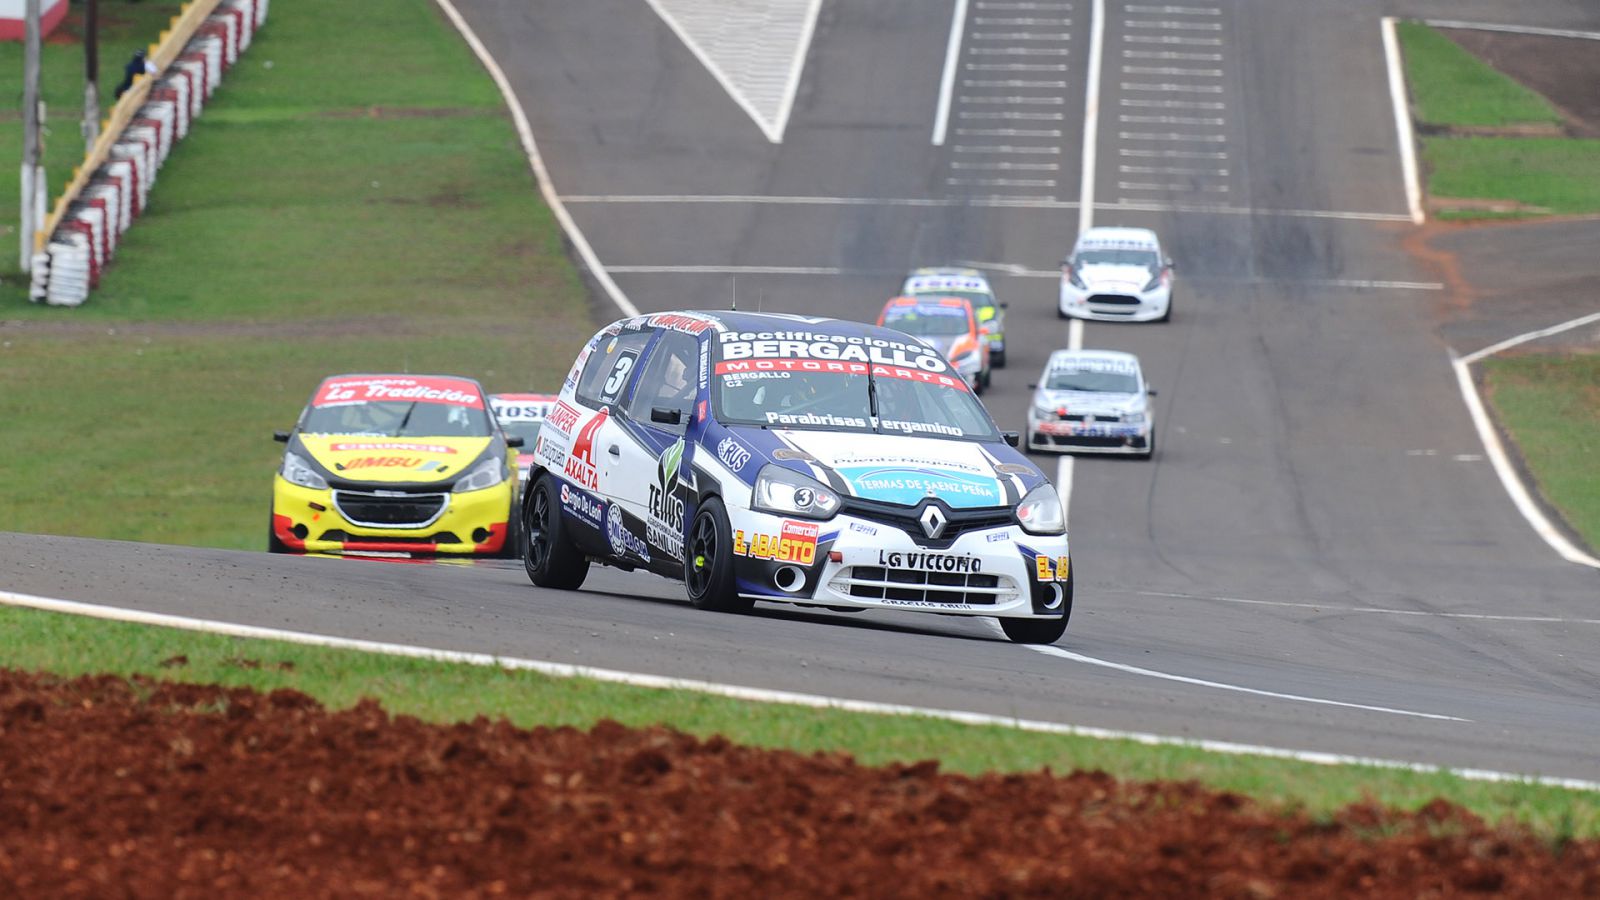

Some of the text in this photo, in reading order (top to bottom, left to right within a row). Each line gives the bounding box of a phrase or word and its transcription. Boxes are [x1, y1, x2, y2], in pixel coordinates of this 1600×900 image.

[719, 331, 937, 356] Rectificaciones
[722, 341, 947, 372] BERGALLO
[605, 357, 633, 395] 3
[723, 371, 791, 382] BERGALLO
[725, 379, 743, 388] C2
[726, 361, 955, 386] MOTORPARTS
[325, 385, 478, 404] La Tradición
[766, 411, 963, 437] Parabrisas Pergamino
[723, 442, 751, 472] RUS
[564, 457, 598, 492] AXALTA
[797, 489, 811, 506] 3
[859, 479, 993, 497] TERMAS DE SAENZ PEÑA
[783, 522, 817, 537] Comercial
[735, 530, 814, 564] EL ABASTO
[1037, 555, 1053, 579] EL
[881, 599, 936, 608] GRACIAS
